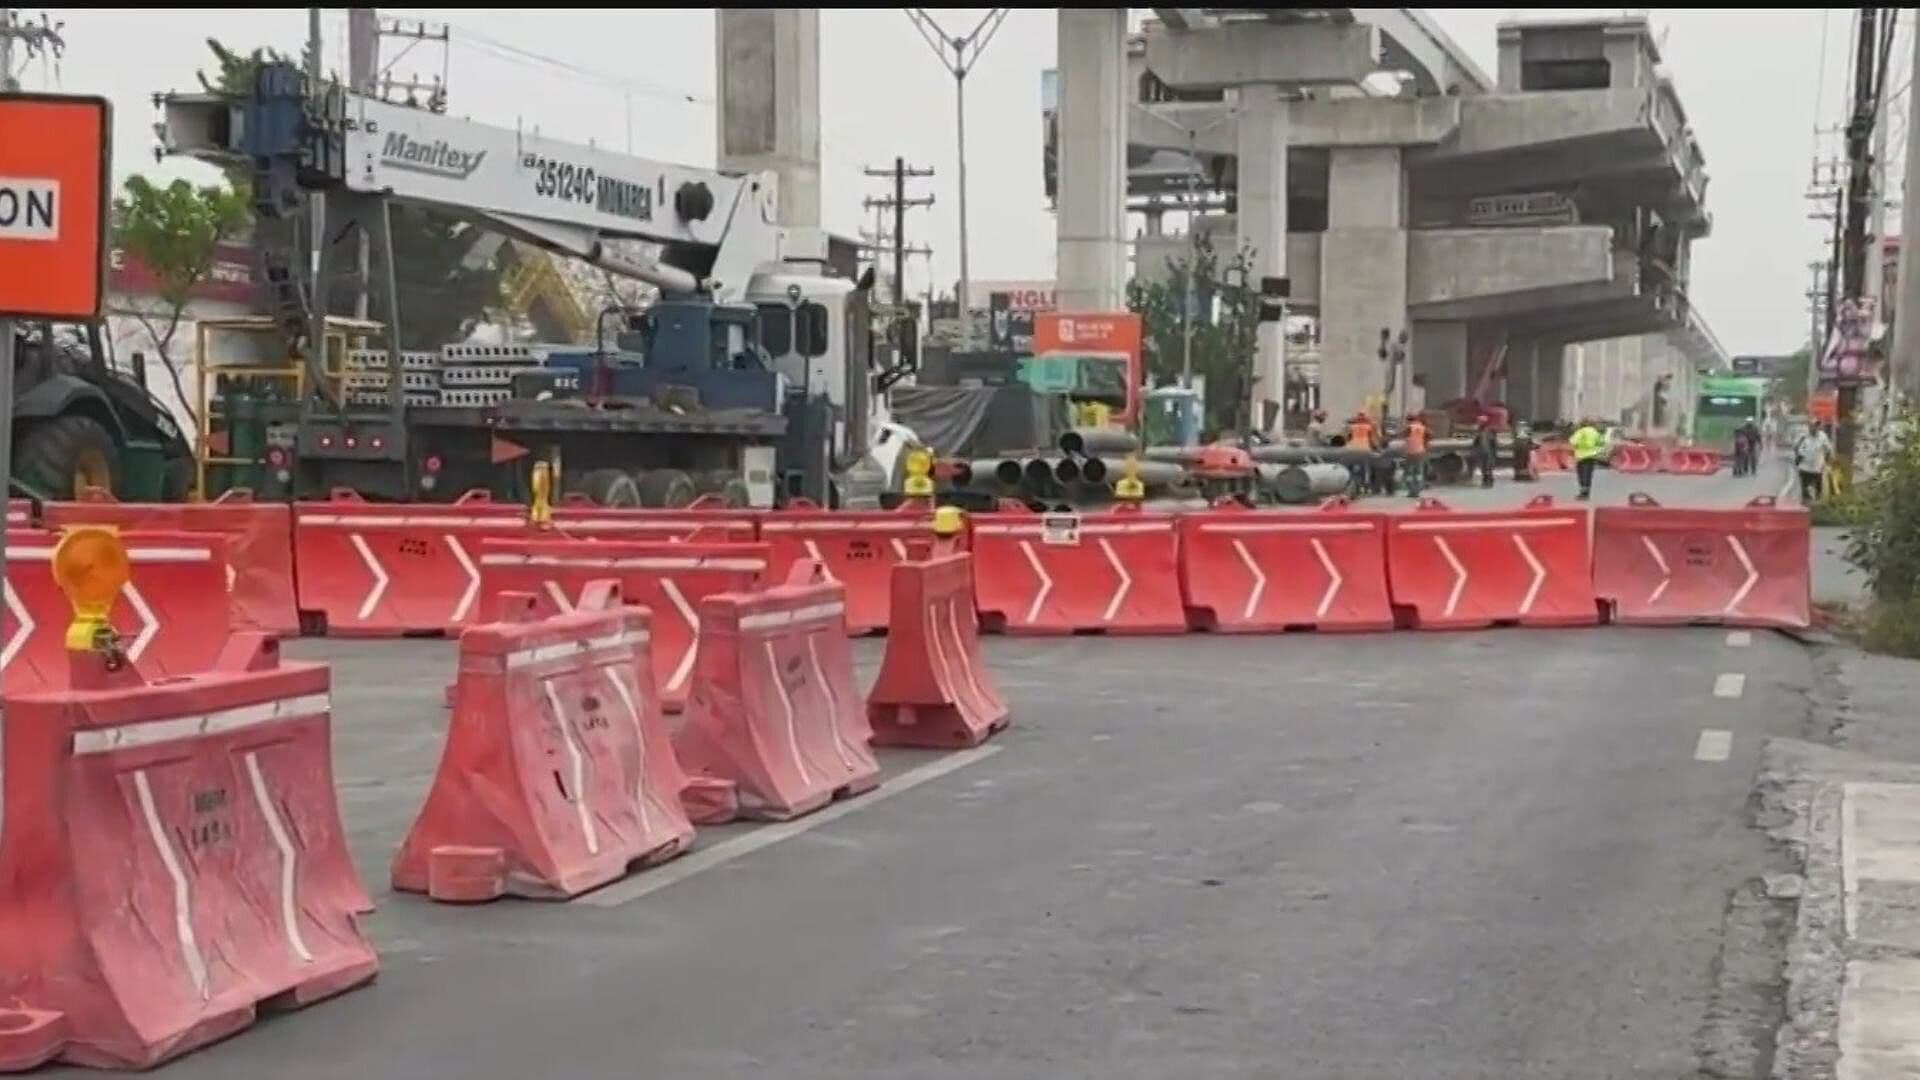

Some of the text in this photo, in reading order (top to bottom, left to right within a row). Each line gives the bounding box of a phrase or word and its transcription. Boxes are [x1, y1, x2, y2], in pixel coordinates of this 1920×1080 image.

[382, 131, 488, 174] Manitex
[535, 158, 596, 204] 35124C
[0, 187, 54, 227] ON
